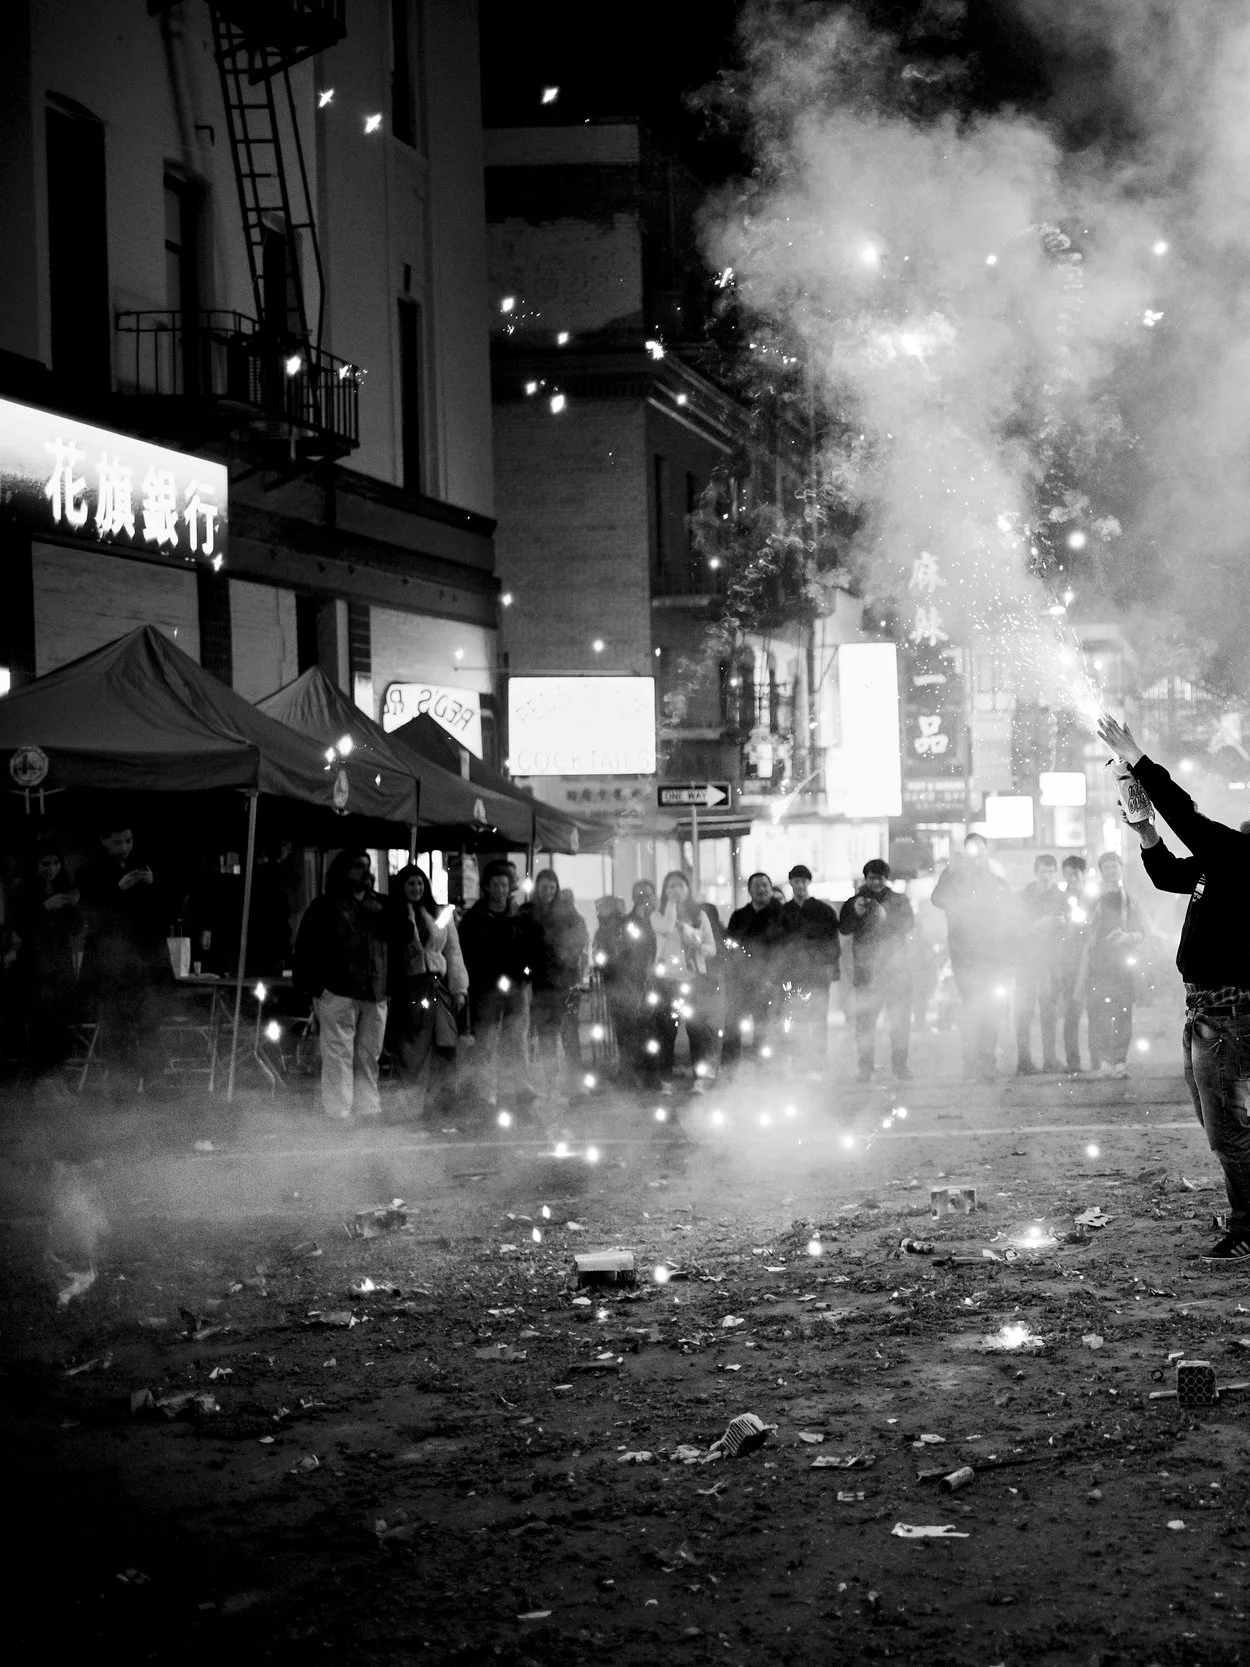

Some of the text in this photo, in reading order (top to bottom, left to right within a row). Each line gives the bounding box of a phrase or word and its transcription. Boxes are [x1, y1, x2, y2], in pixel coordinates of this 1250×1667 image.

[44, 437, 218, 557] 花旗銀行
[664, 790, 706, 801] ONE WAY
